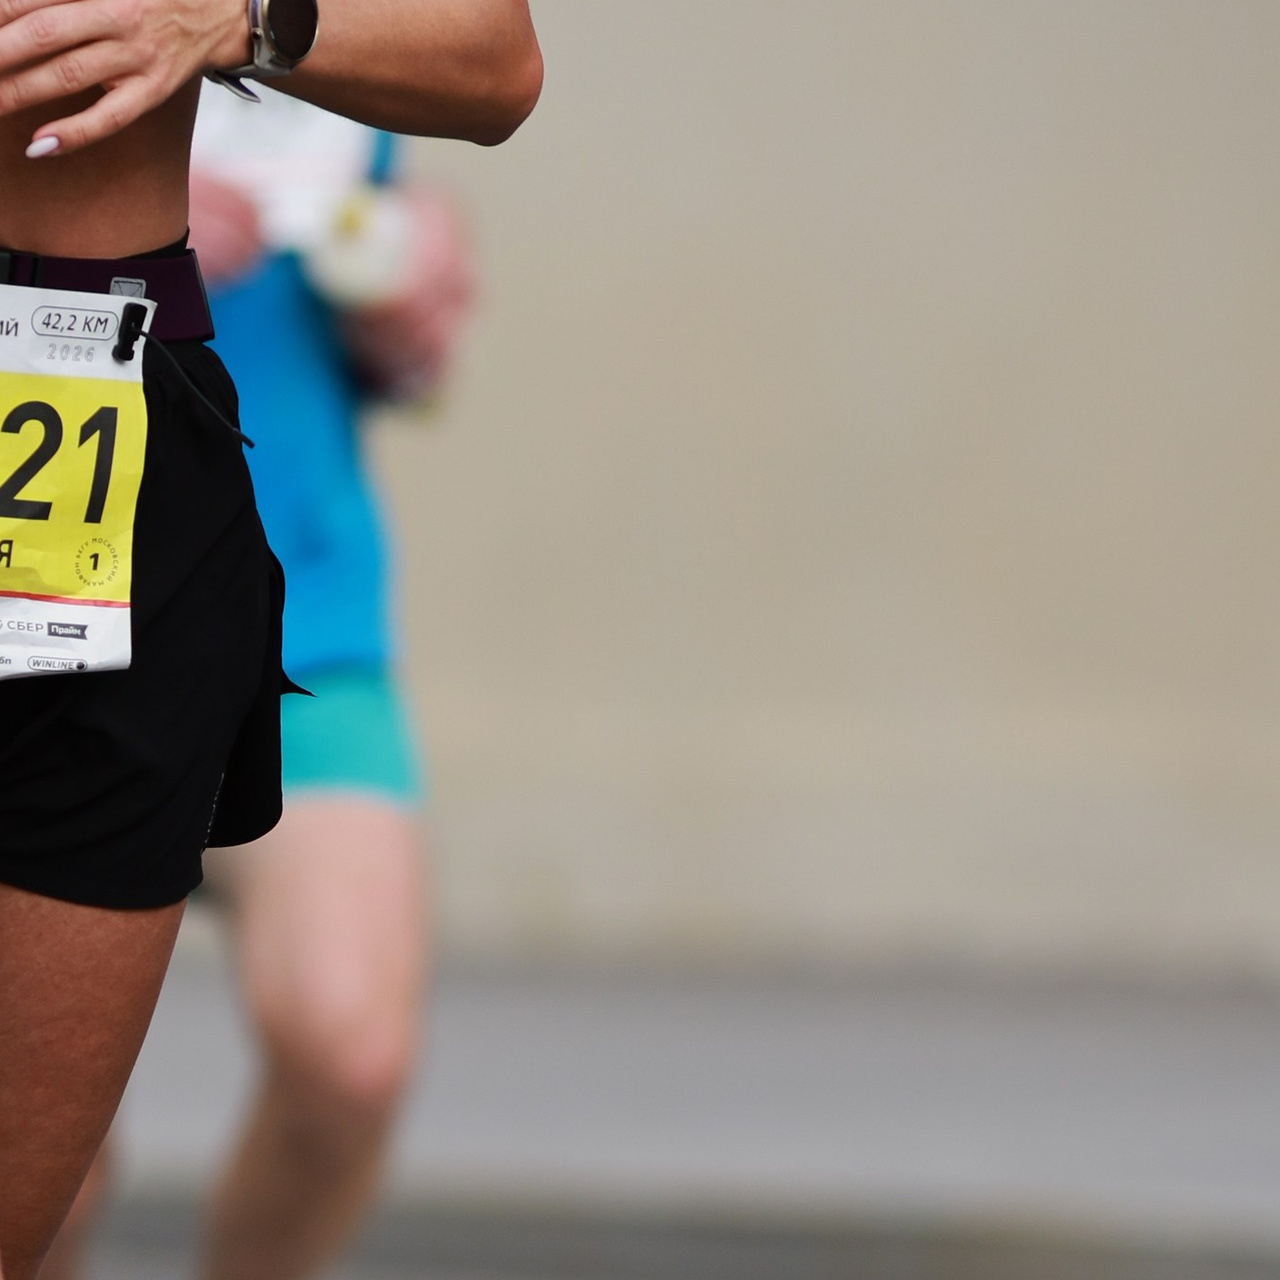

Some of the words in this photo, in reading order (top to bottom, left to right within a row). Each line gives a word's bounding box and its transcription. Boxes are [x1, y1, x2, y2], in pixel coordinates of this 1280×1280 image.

[42, 312, 77, 333] 42,2
[46, 343, 95, 362] 2026
[89, 552, 99, 571] 1
[6, 620, 44, 633] СБЕР
[32, 659, 74, 670] WINLINE
